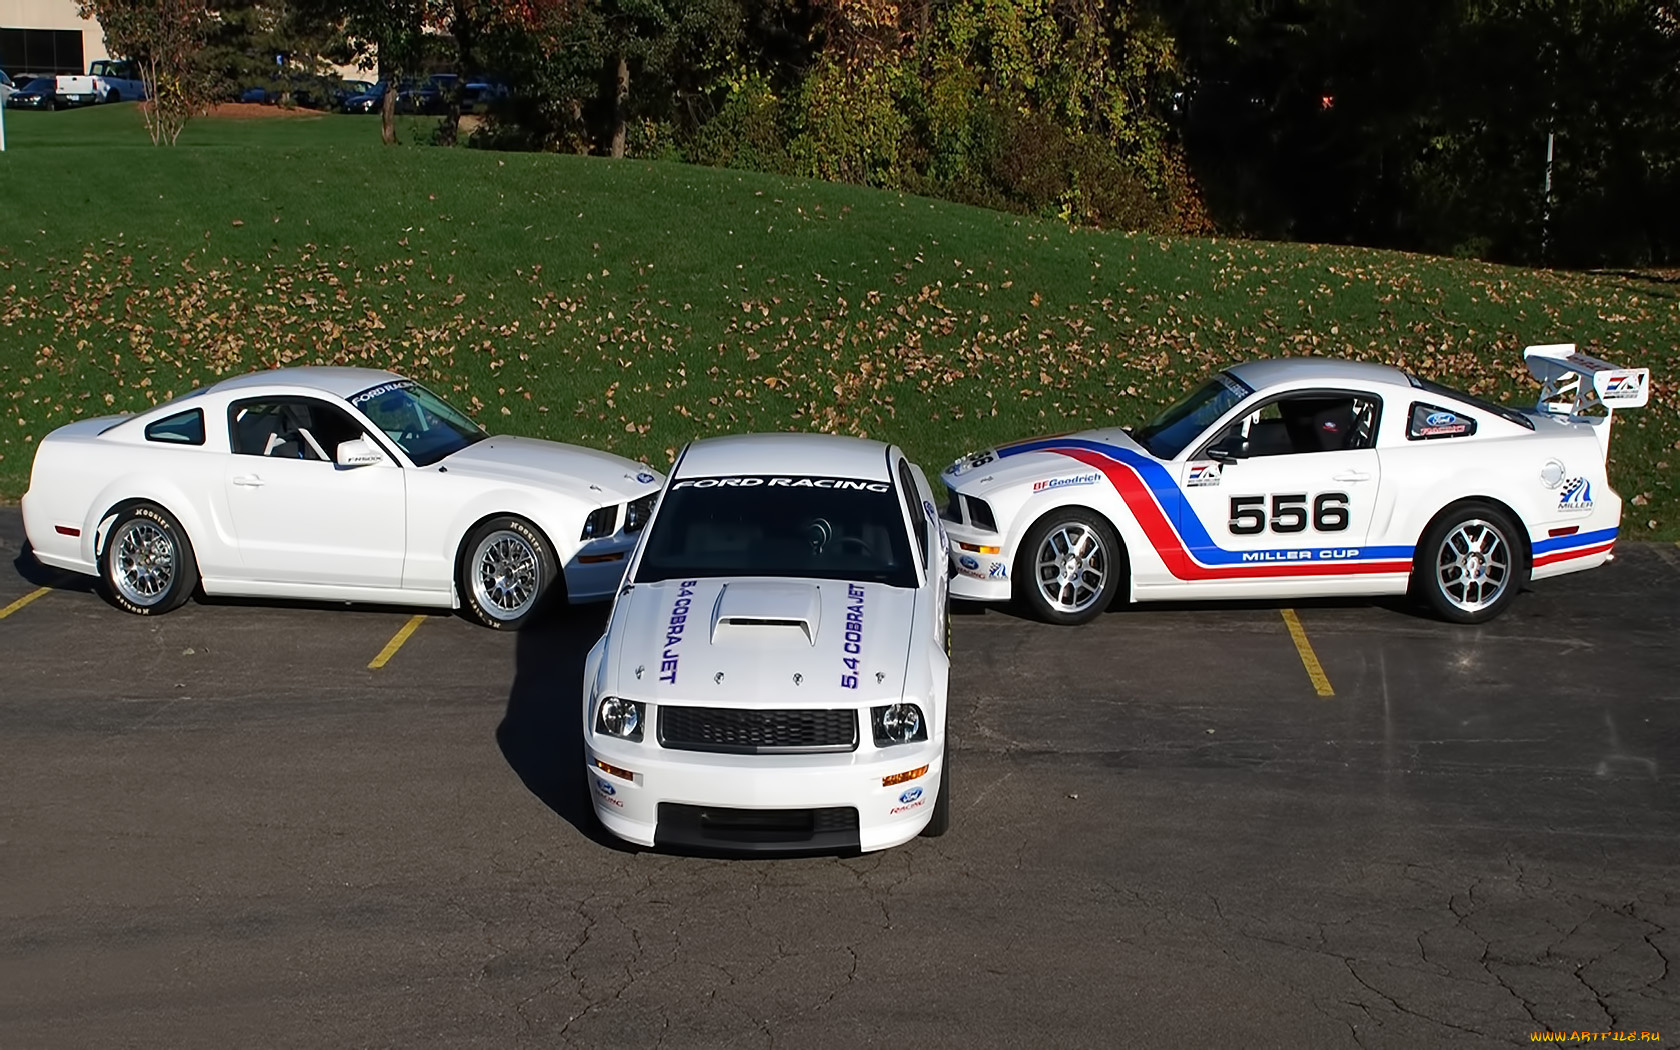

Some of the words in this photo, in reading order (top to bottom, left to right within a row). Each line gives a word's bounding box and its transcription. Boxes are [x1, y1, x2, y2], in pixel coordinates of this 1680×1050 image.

[352, 388, 387, 407] FORD
[671, 478, 764, 491] FORD
[767, 478, 889, 493] RACING
[1033, 473, 1102, 491] BFGoodrich
[1228, 491, 1350, 536] 556
[1242, 551, 1312, 561] MILLER
[1319, 549, 1360, 559] CUP
[848, 583, 865, 604] JET
[664, 598, 692, 649] COBRA
[844, 604, 864, 654] COBRA
[659, 649, 680, 684] JET
[841, 657, 861, 689] 5.4
